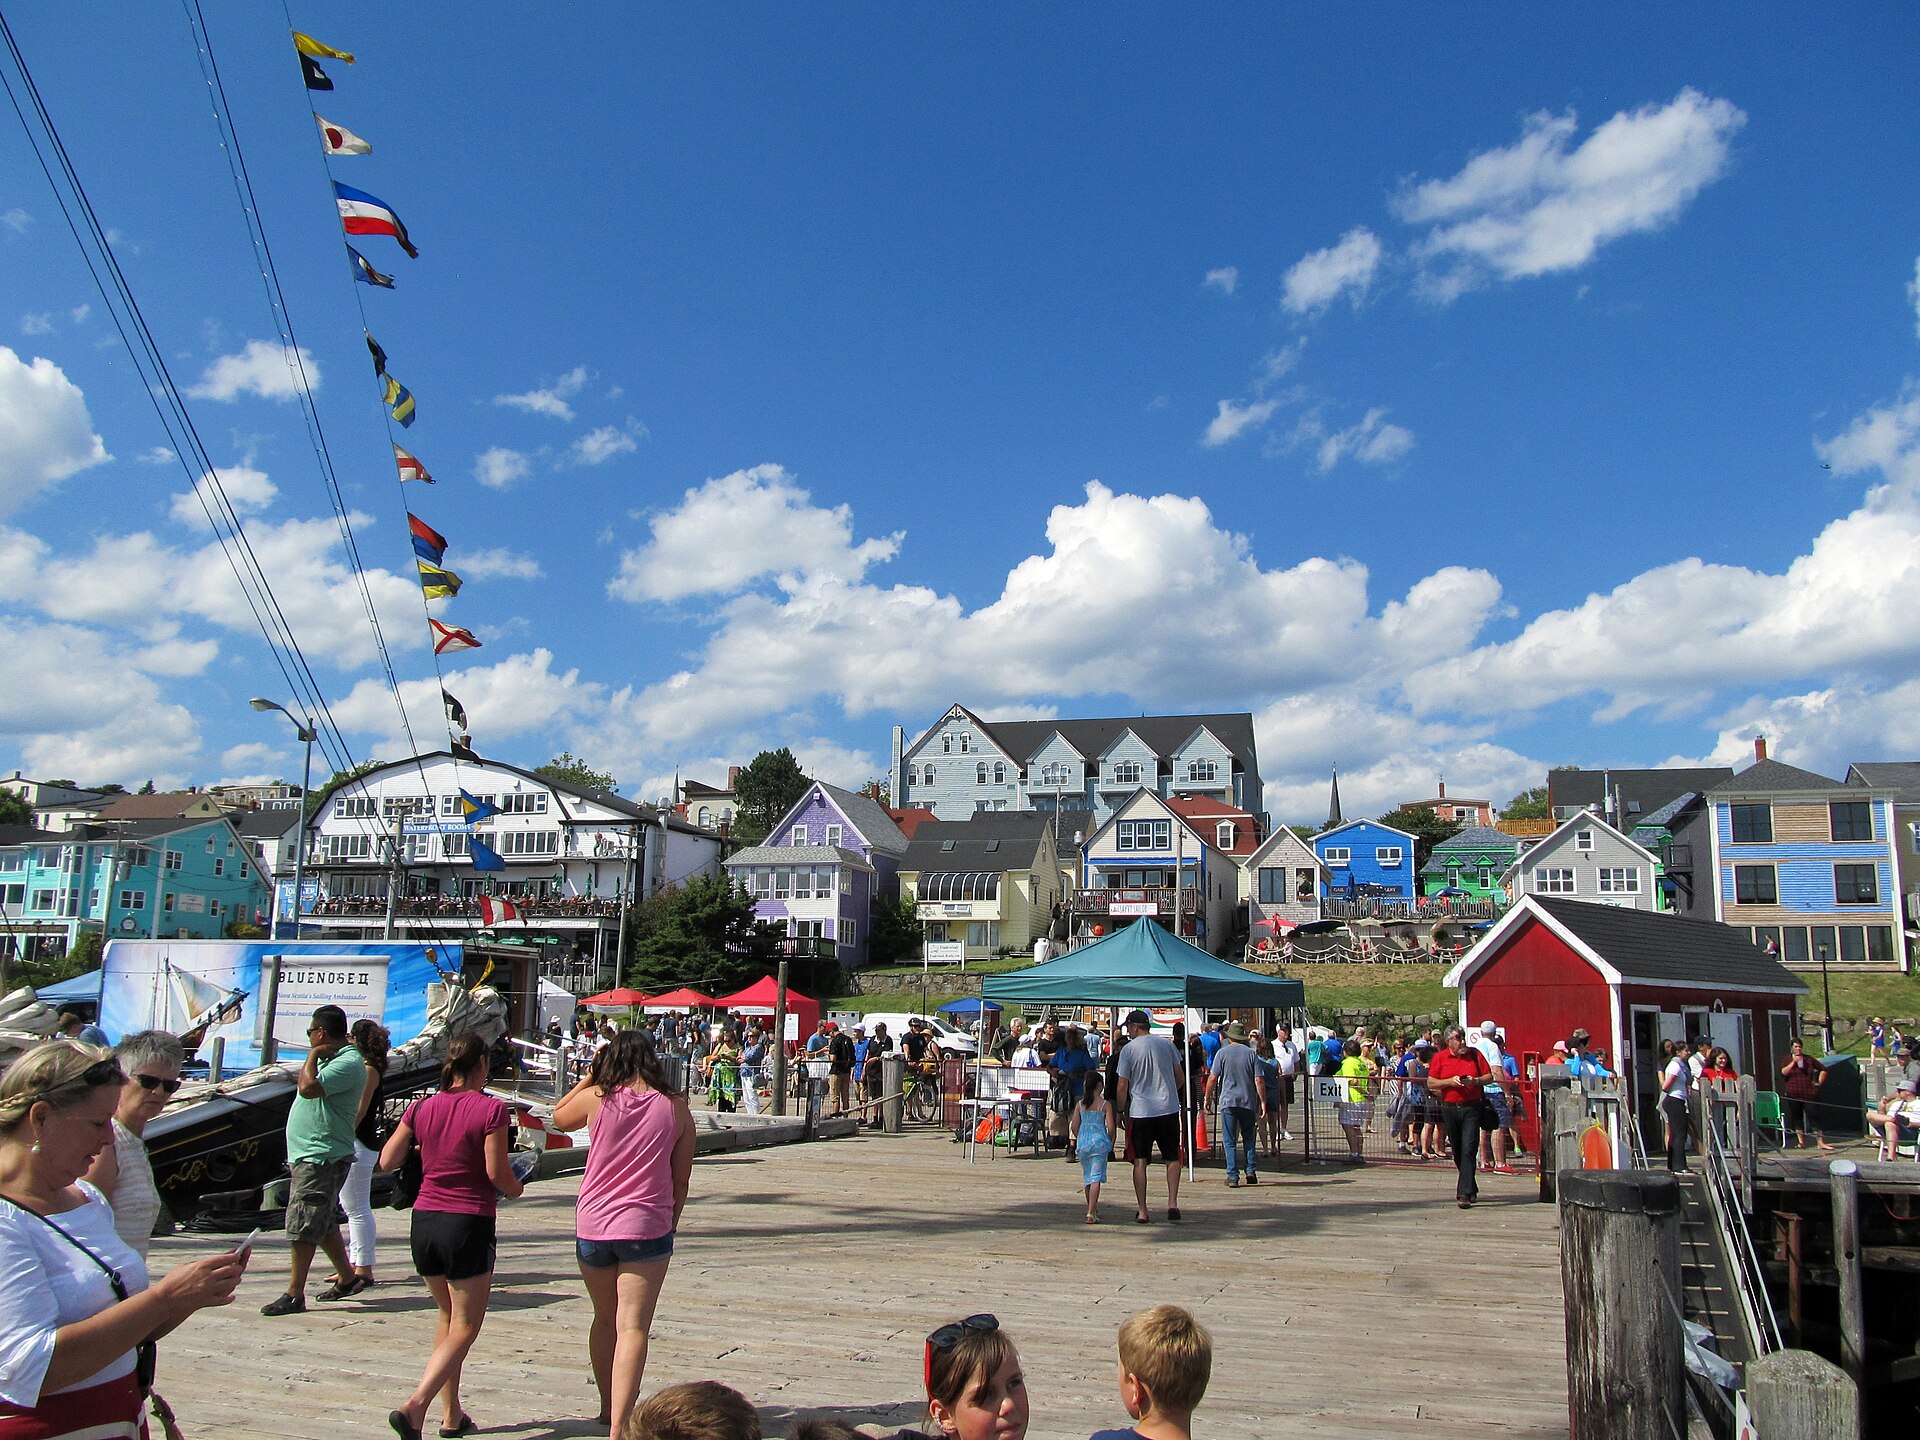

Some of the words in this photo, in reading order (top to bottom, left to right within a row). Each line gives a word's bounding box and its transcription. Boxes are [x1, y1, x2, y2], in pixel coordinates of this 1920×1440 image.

[403, 824, 446, 832] WATERFRONT
[447, 823, 471, 831] ROOMS
[279, 971, 355, 985] BLUENOSE
[291, 992, 312, 1000] Scotia's
[313, 993, 332, 1001] Sailing
[1320, 1082, 1342, 1097] Exit
